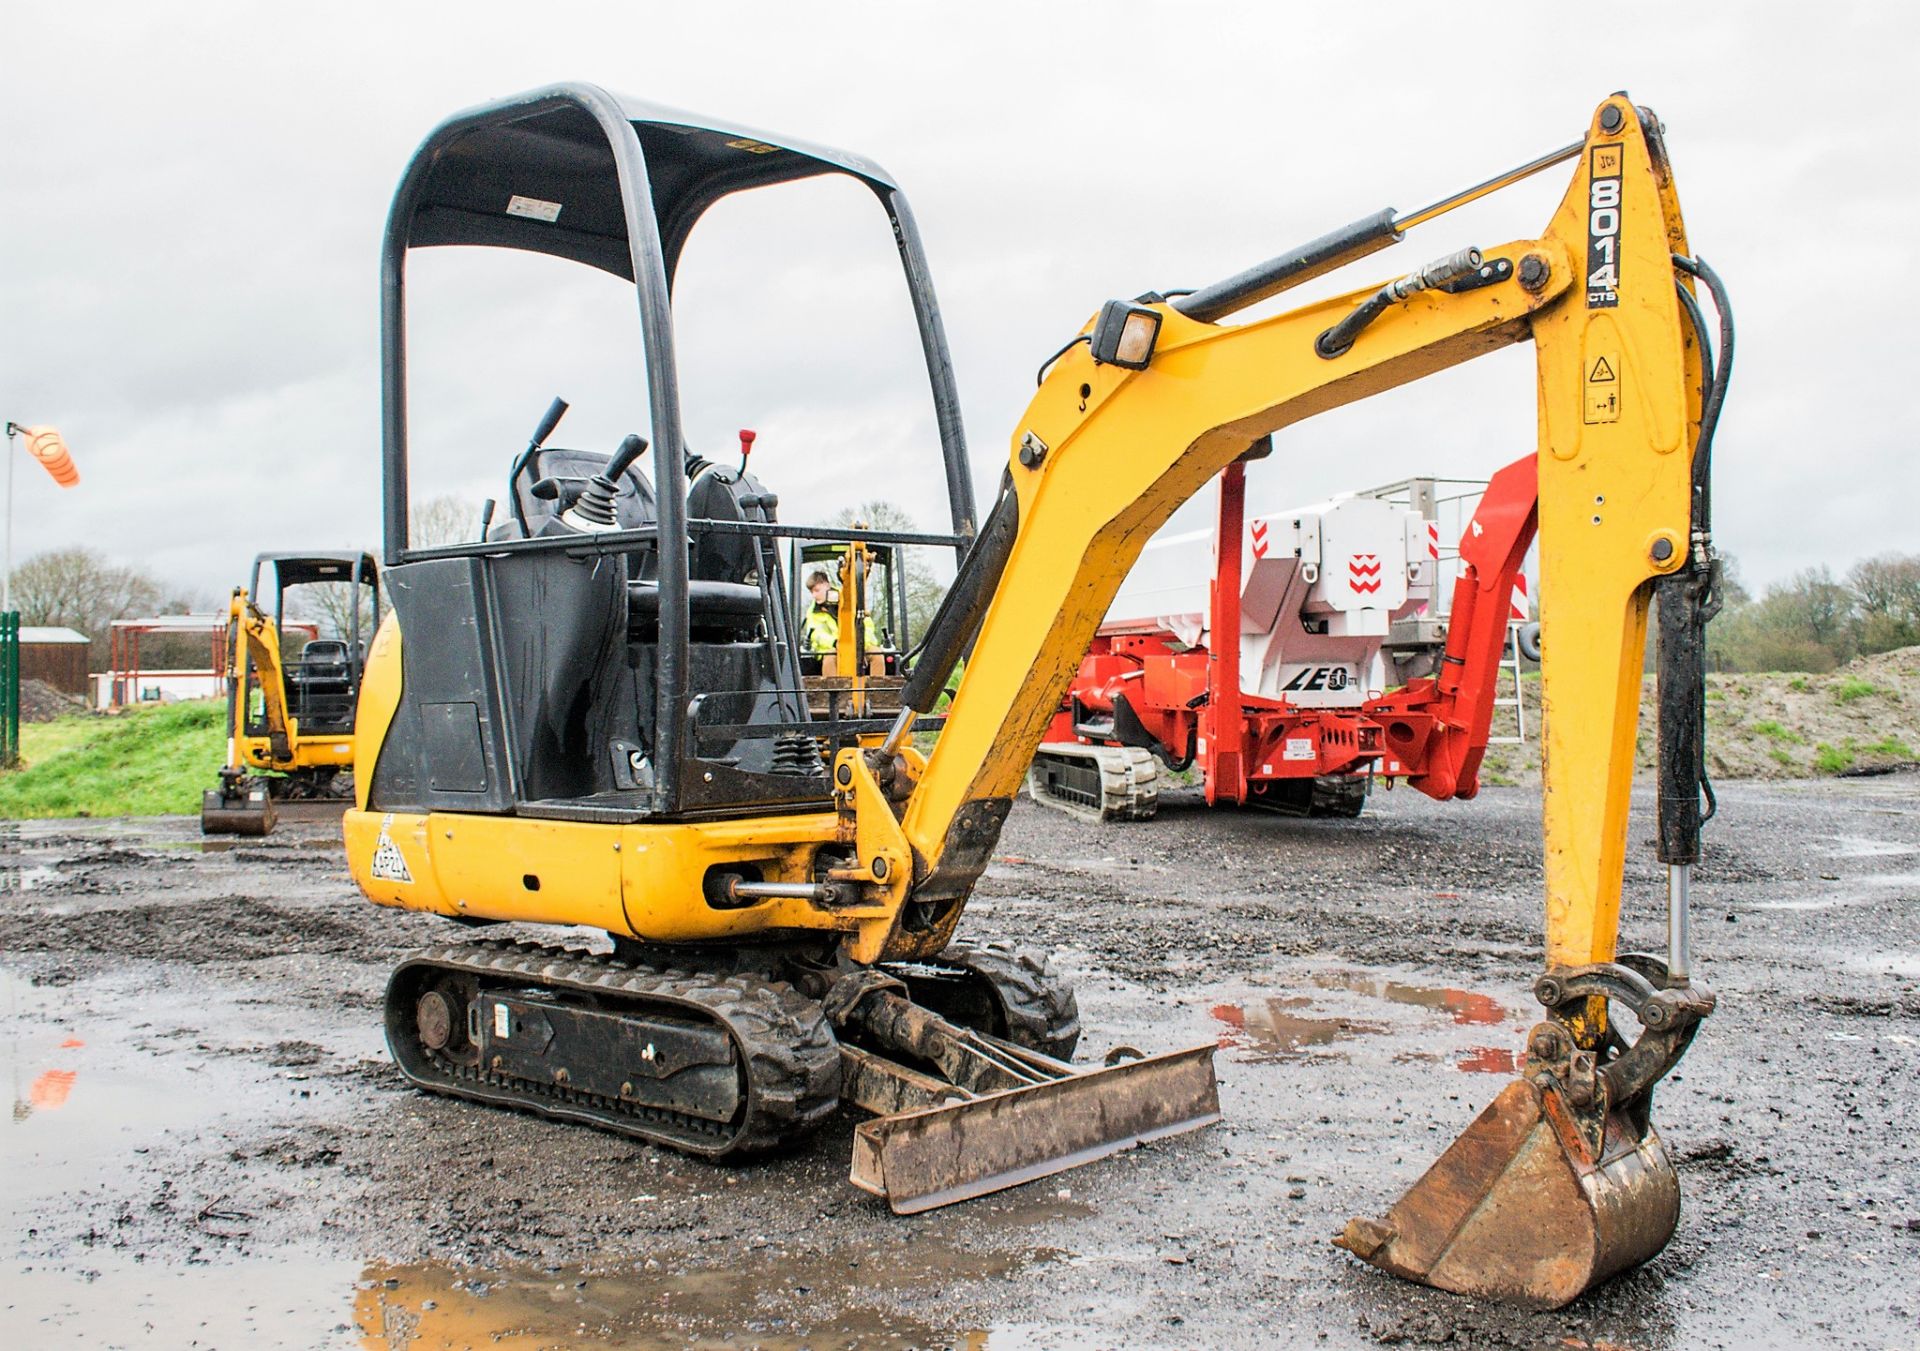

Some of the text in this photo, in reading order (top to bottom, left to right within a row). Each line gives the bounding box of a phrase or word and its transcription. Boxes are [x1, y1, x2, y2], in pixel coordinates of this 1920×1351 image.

[1599, 155, 1617, 169] JCB
[1588, 179, 1621, 292] 8014
[1587, 292, 1617, 302] CTS
